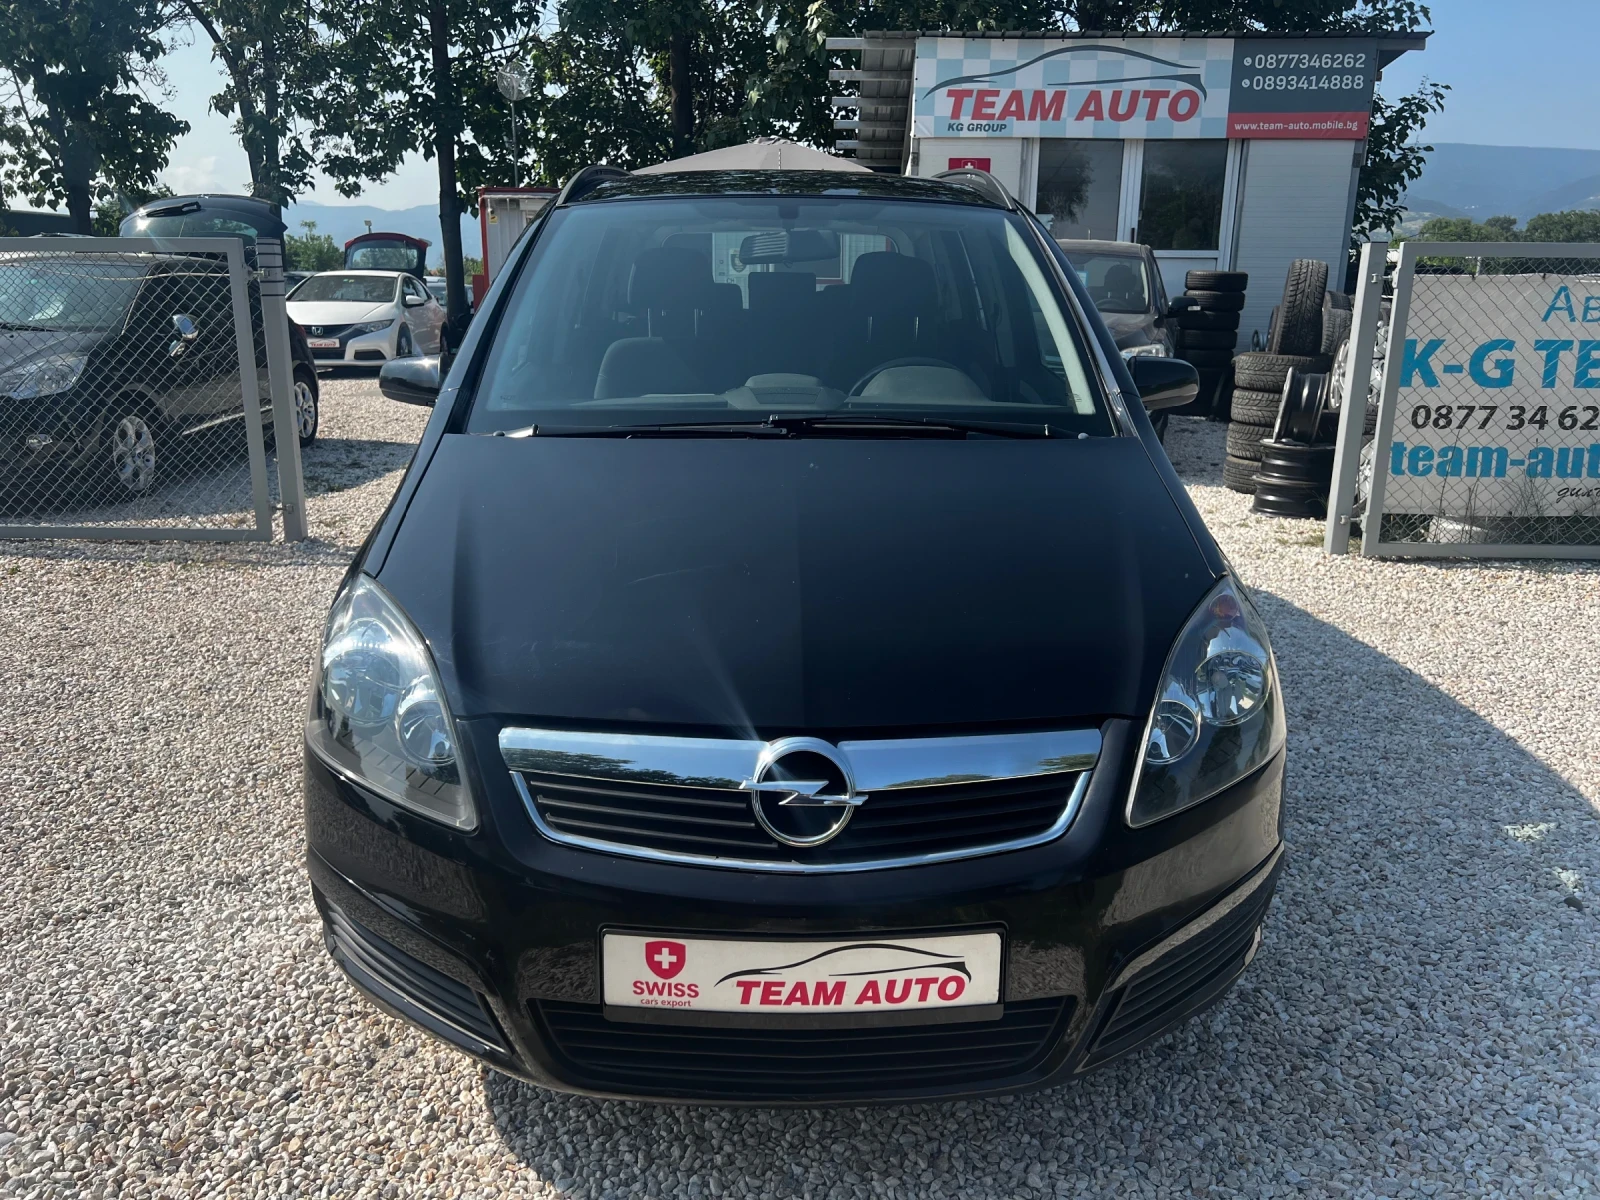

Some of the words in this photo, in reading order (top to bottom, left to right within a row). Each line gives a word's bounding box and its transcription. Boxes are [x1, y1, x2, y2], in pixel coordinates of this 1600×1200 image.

[1254, 53, 1366, 69] 0877346262
[1252, 75, 1364, 90] 0893414888
[946, 89, 1067, 121] TEAM
[1074, 89, 1200, 122] AUTO
[947, 123, 964, 132] KG
[967, 123, 1007, 132] GROUP
[1234, 120, 1358, 131] www.team-auto.mobile.bg
[1401, 338, 1516, 388] K-G
[1534, 339, 1600, 388] TE
[1411, 405, 1498, 430] 0877
[1506, 405, 1548, 430] 34
[1558, 405, 1600, 430] 62
[632, 980, 699, 998] SWISS
[735, 980, 847, 1006] TEAM
[855, 975, 966, 1004] AUTO
[661, 999, 691, 1008] export
